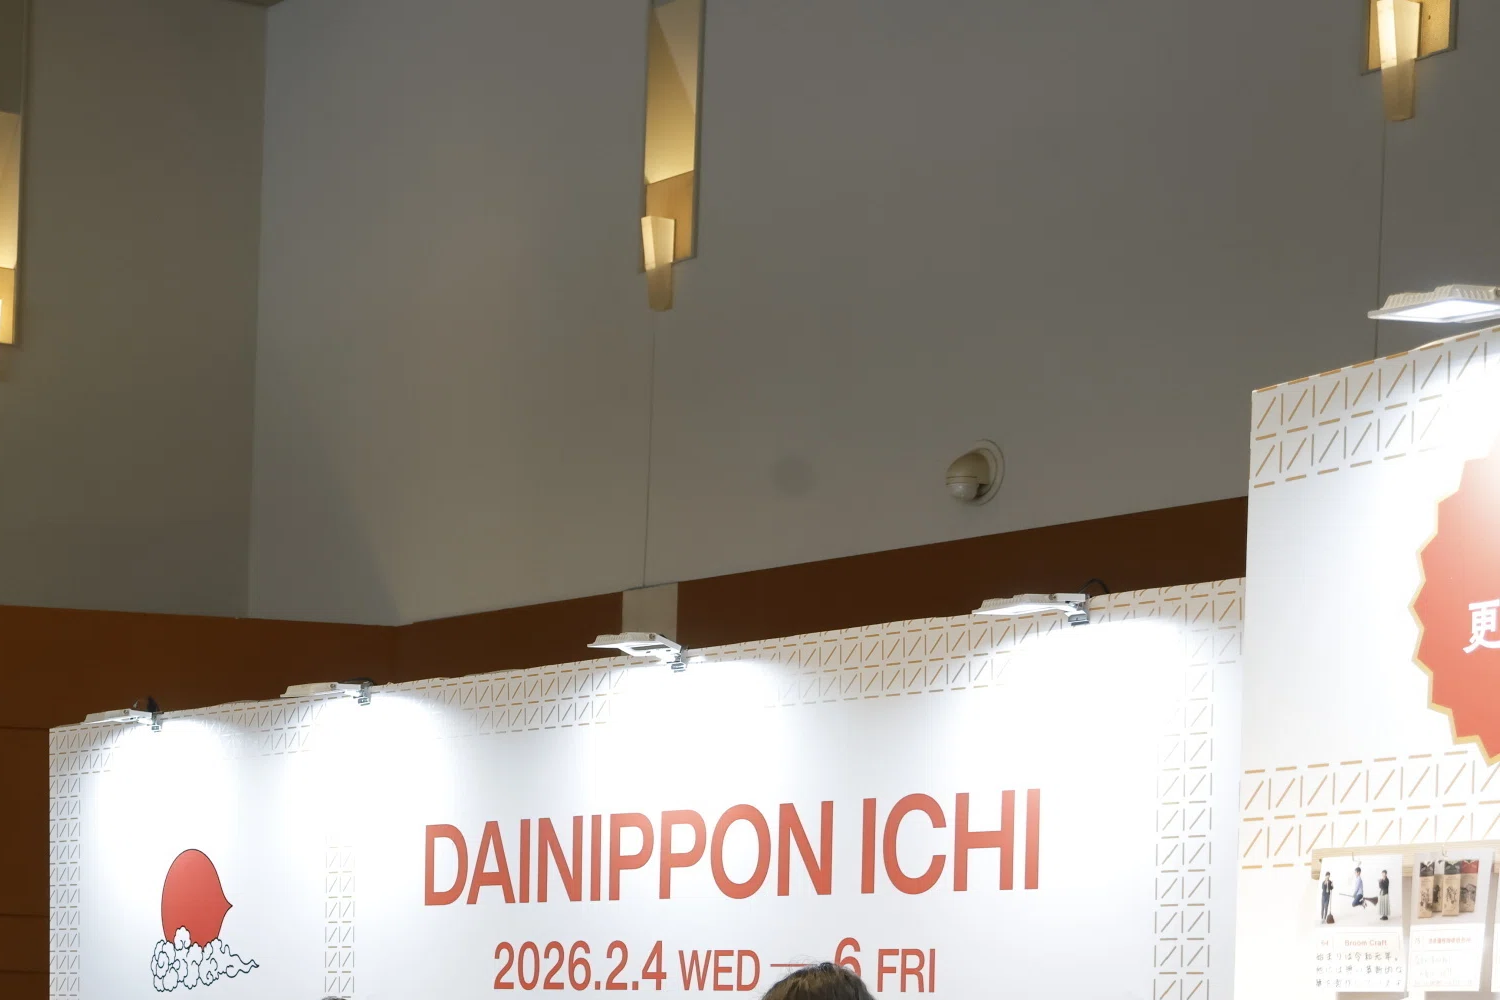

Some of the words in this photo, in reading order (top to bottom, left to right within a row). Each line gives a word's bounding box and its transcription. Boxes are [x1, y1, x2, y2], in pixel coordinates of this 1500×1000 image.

[424, 801, 834, 906] DAINIPPON
[860, 788, 1041, 896] ICHI
[493, 940, 668, 991] 2026.2.4
[678, 949, 761, 992] WED
[876, 948, 936, 993] FRI
[1344, 939, 1367, 947] Broom
[1369, 938, 1387, 946] Craft
